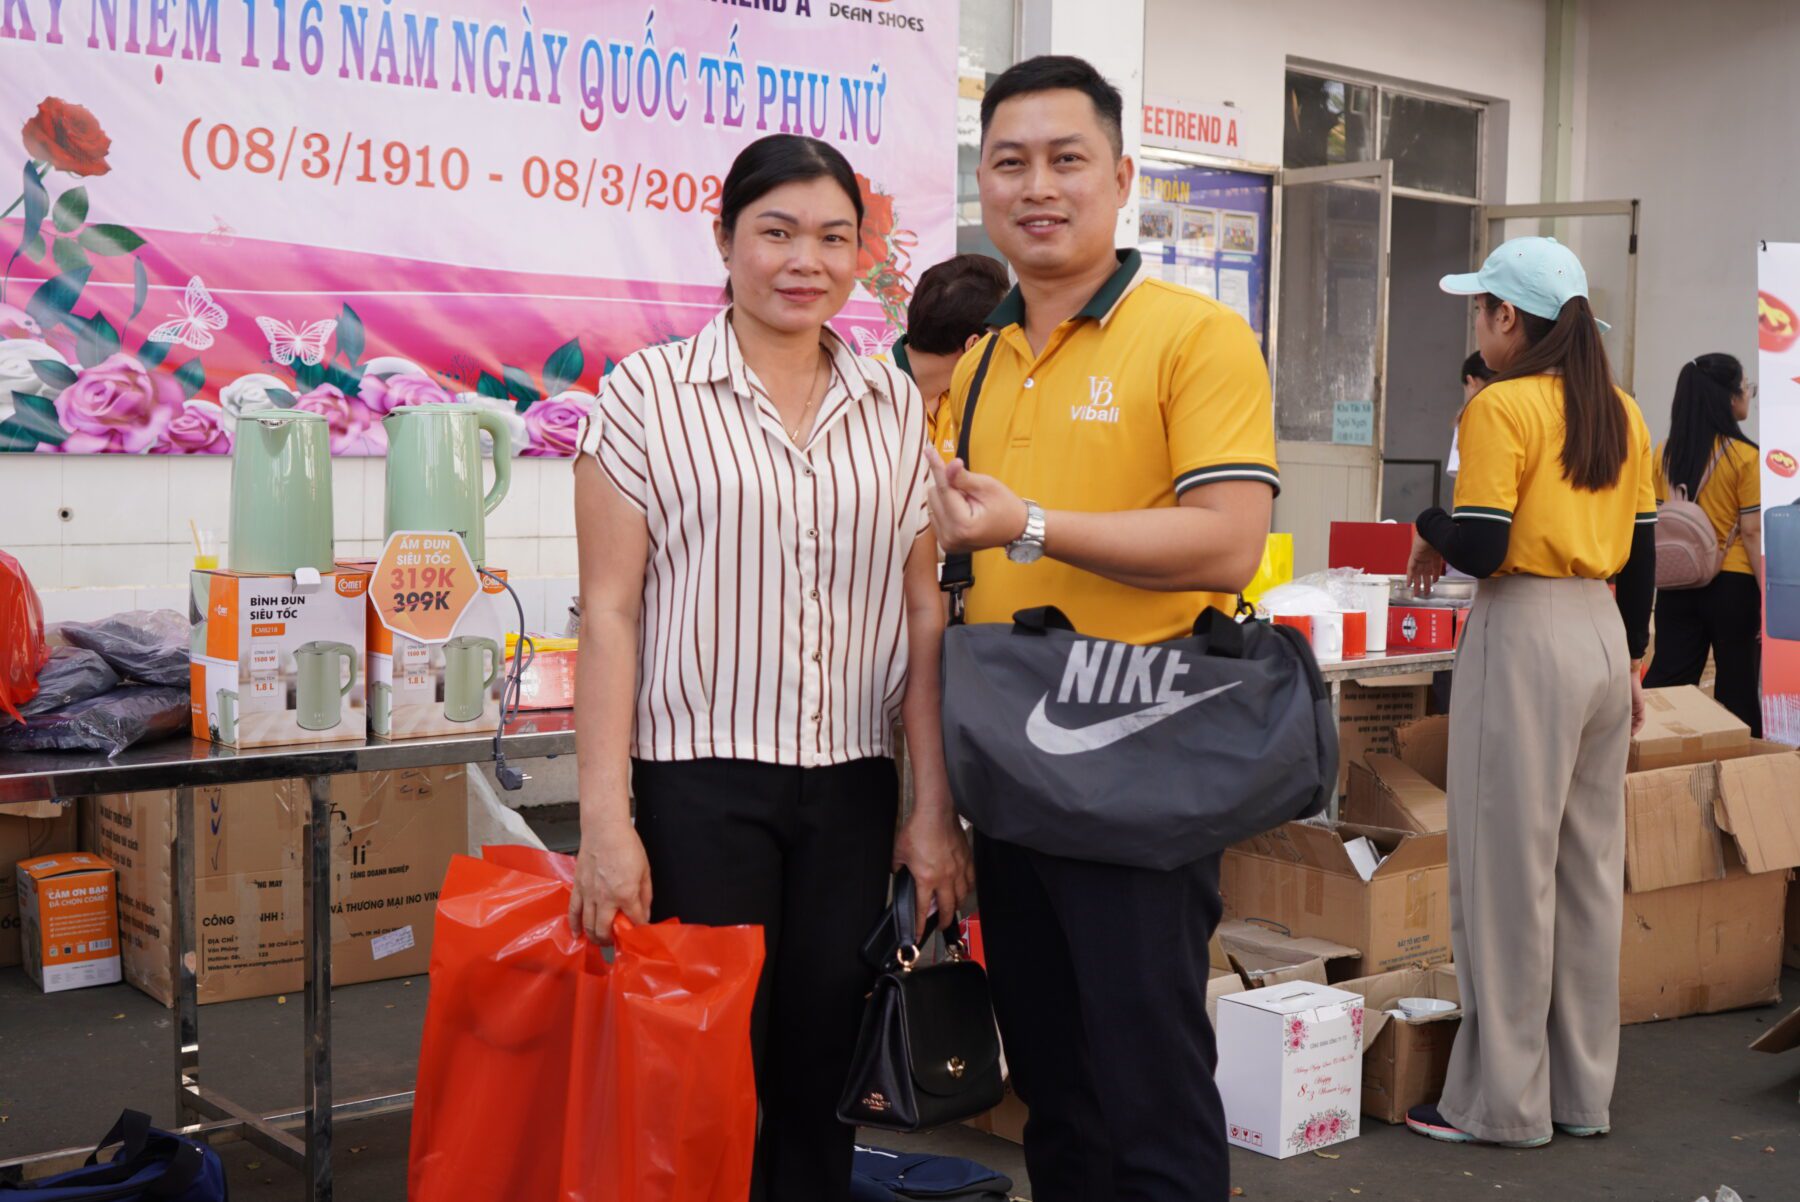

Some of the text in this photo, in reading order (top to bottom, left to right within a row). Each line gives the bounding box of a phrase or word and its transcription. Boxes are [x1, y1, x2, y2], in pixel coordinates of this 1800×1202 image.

[829, 2, 924, 32] DEAN SHOES
[241, 0, 323, 75] 116
[338, 0, 439, 89] NĂM
[451, 6, 568, 104] NGÀY
[580, 10, 687, 132] QUỐC
[698, 23, 745, 127] TẾ
[839, 63, 887, 145] NỮ
[1227, 119, 1238, 147] A
[182, 117, 469, 191] (08/3/1910
[488, 172, 503, 182] -
[400, 534, 450, 550] ẤM ĐUN
[396, 550, 450, 565] SIÊU TỐC
[390, 567, 456, 590] 319K
[250, 595, 305, 606] BÌNH ĐUN
[393, 591, 450, 613] 399K
[250, 607, 298, 620] SIÊU TỐC
[1056, 640, 1191, 703] NIKE
[346, 899, 384, 912] THƯƠNG
[386, 897, 404, 909] MẠI
[406, 893, 422, 904] INO
[424, 891, 442, 902] VIN
[202, 913, 235, 926] CÔNG
